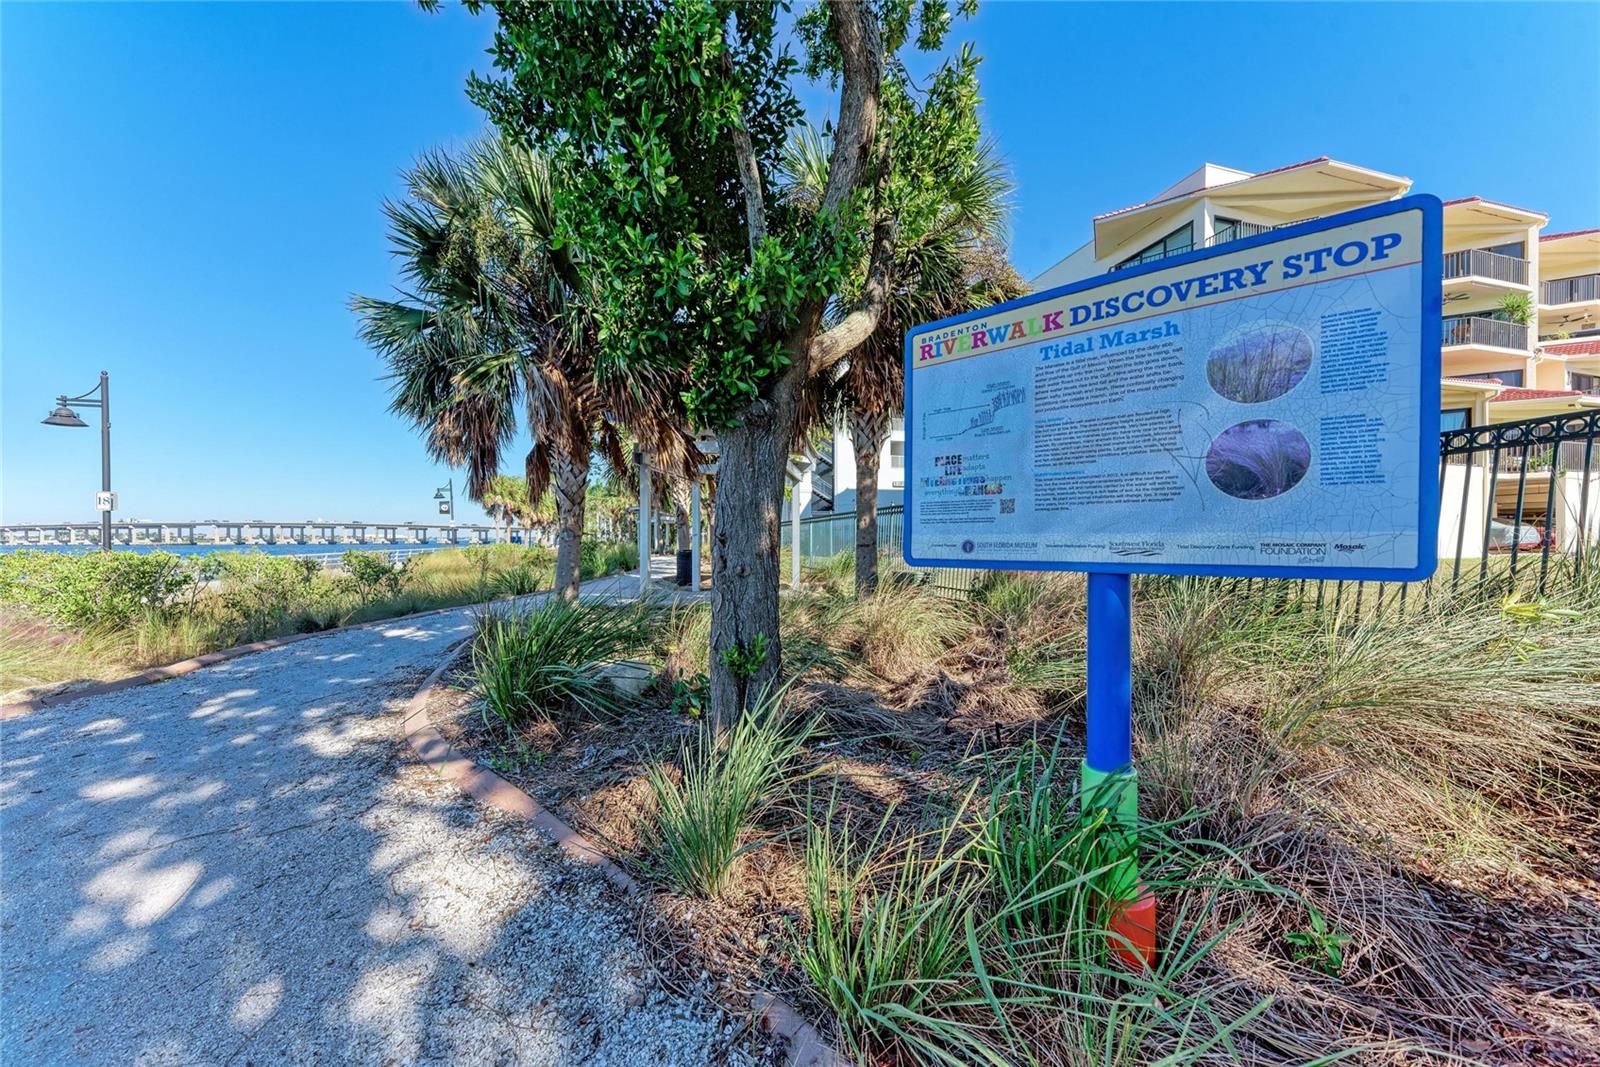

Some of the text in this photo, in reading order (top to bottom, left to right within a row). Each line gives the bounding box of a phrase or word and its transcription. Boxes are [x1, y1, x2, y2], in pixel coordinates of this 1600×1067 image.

[920, 232, 1402, 361] RIVERWALK DISCOVERY STOP
[921, 322, 988, 344] BRADENTON
[1040, 320, 1181, 361] Tidal Marsh
[935, 454, 962, 466] PLACE
[976, 541, 993, 549] SOUTH
[994, 541, 1013, 549] FLORIDA
[1014, 541, 1038, 549] MUSEUM
[1260, 547, 1327, 556] FOUNDATION
